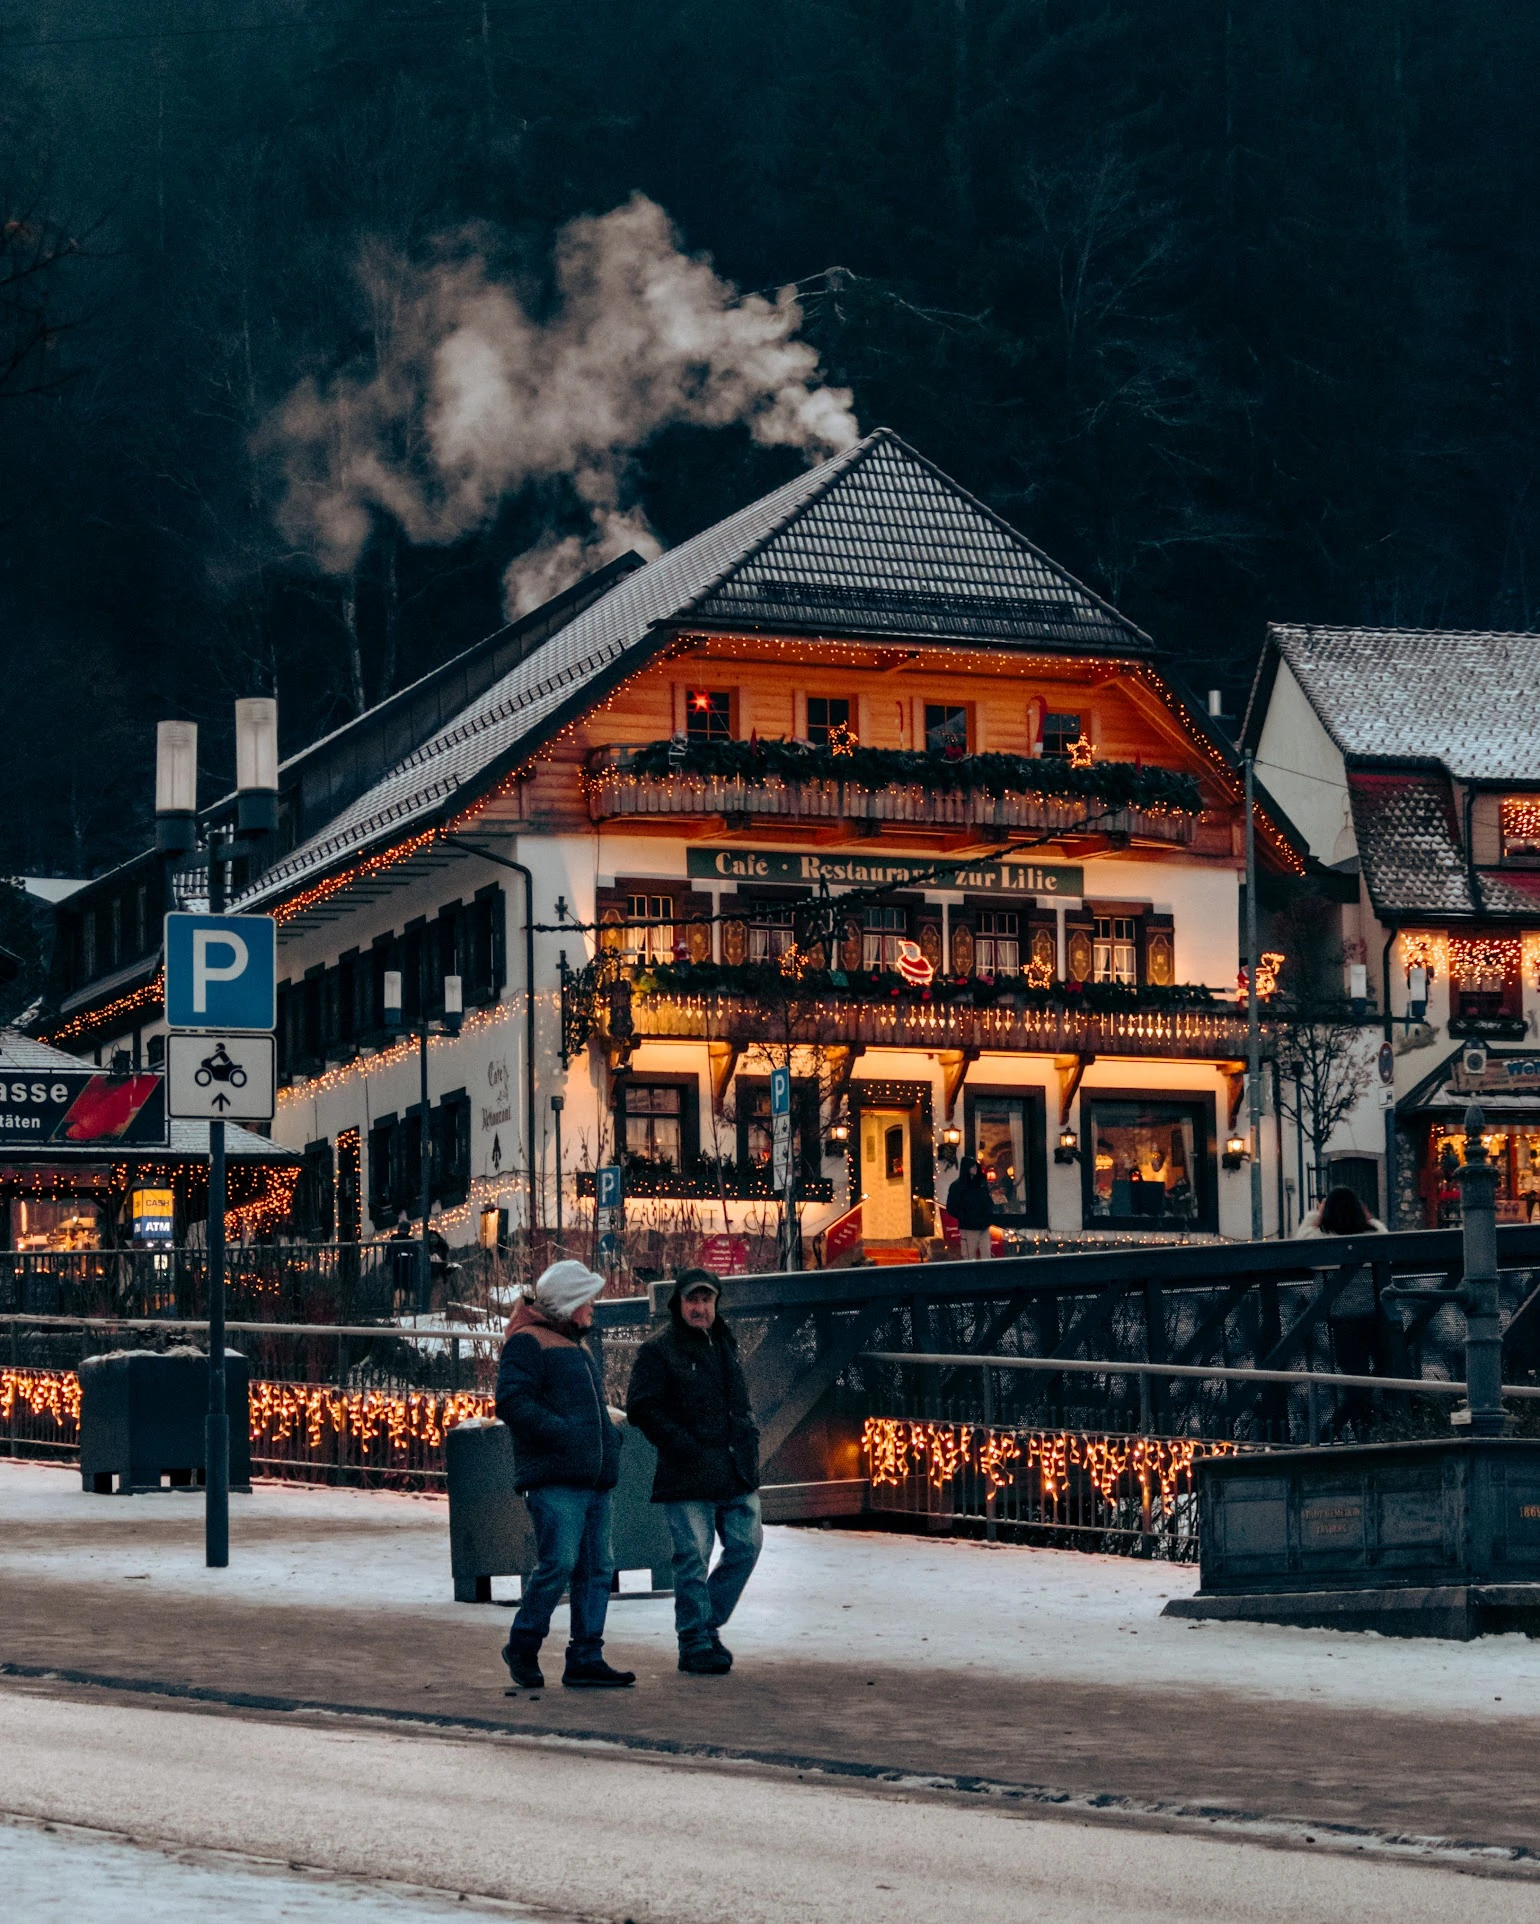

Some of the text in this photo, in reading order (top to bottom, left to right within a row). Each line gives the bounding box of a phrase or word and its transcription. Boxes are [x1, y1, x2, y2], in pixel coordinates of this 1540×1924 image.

[715, 852, 1058, 891] Café Restaurant zur Lilie
[193, 929, 249, 1013] P
[775, 1074, 785, 1109] P
[145, 1199, 170, 1207] CASH
[601, 1172, 613, 1204] P
[145, 1222, 170, 1232] ATM
